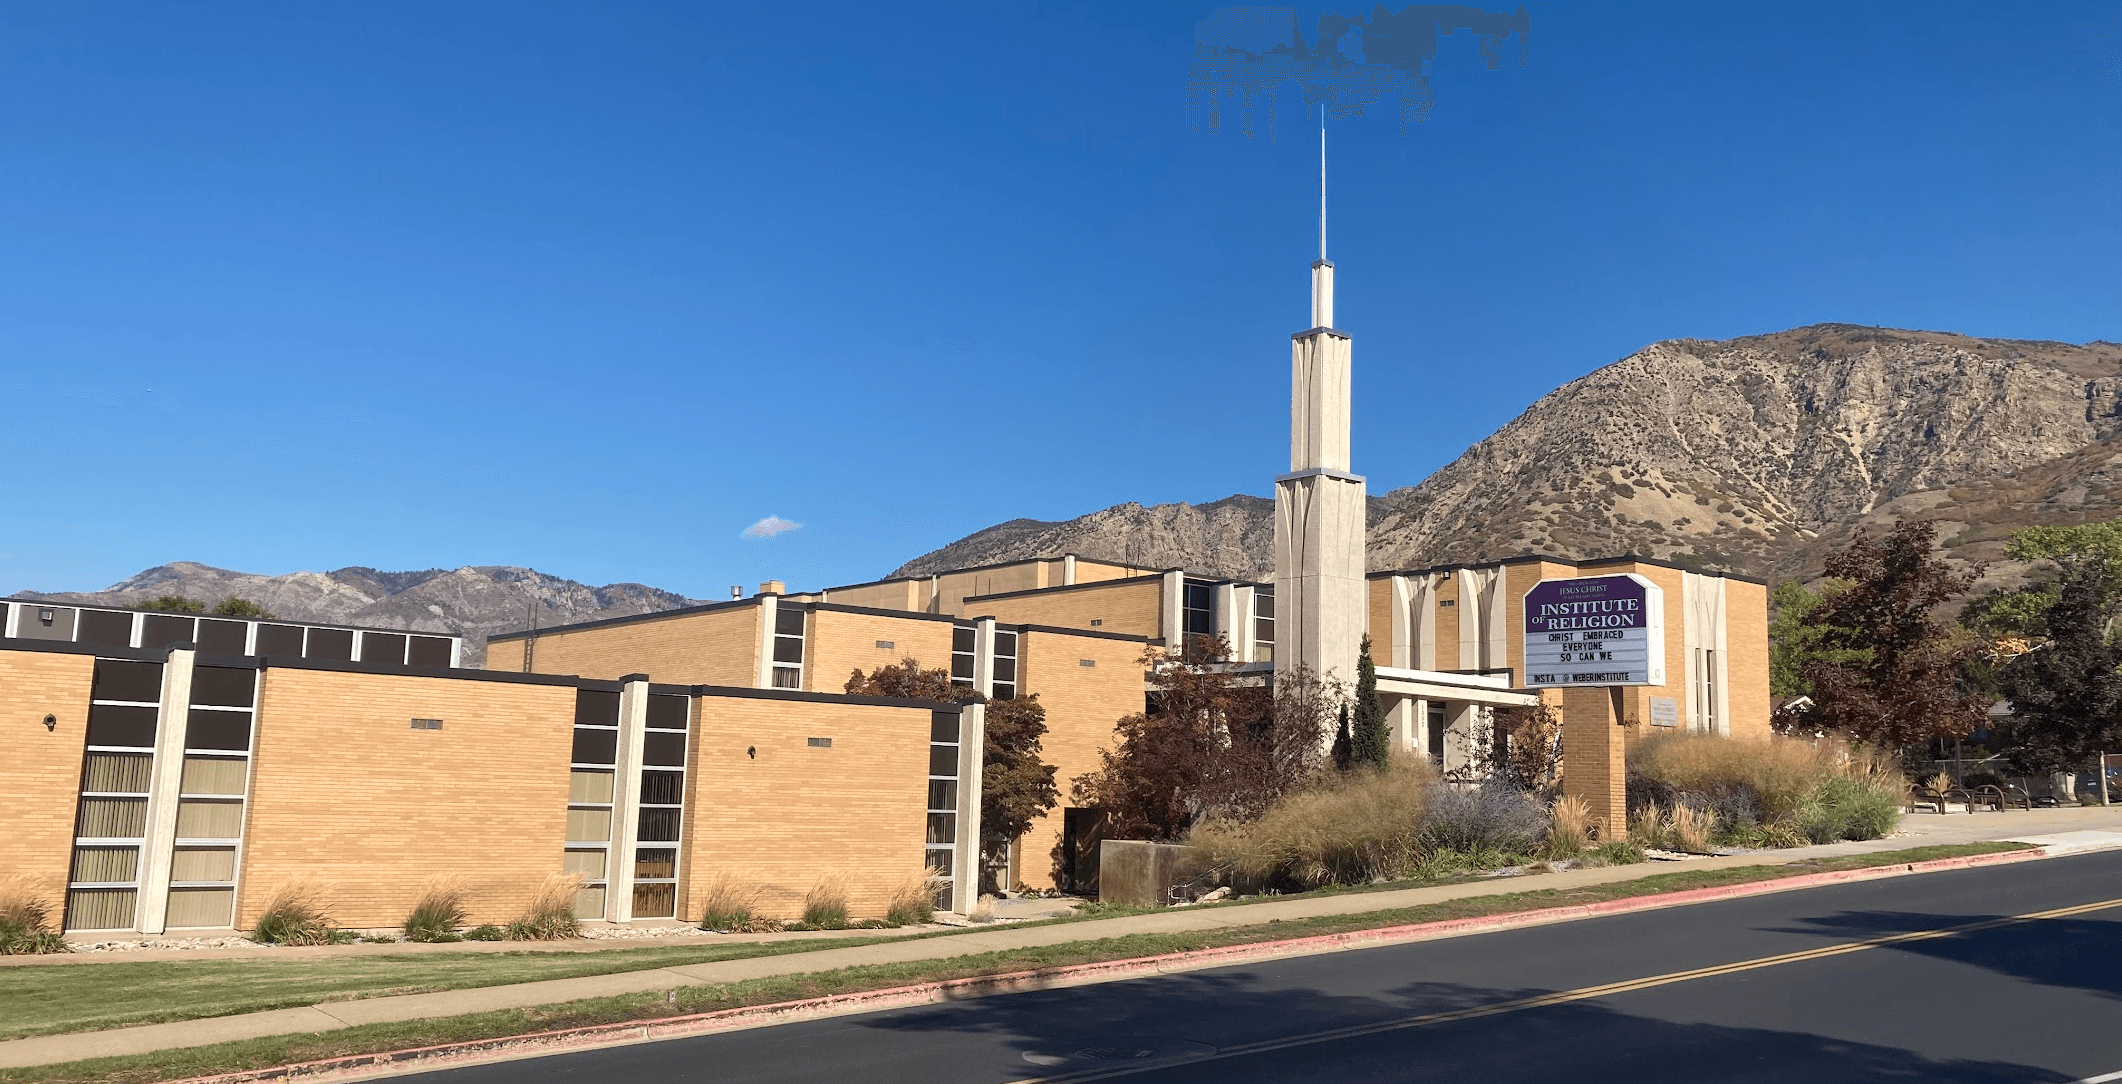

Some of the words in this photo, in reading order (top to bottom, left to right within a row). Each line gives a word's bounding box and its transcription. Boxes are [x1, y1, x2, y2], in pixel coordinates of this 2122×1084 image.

[1560, 587, 1580, 595] JESUS
[1581, 585, 1607, 594] CHRIST
[1540, 598, 1639, 616] INSTITUTE
[1532, 616, 1546, 624] OF
[1547, 614, 1635, 630] RELIGION
[1548, 633, 1574, 642] CHRIST
[1583, 630, 1624, 640] EMBRACED
[1562, 641, 1603, 651] EVERYONE
[1561, 653, 1572, 662] SO
[1579, 652, 1595, 661] CAN
[1600, 651, 1613, 661] WE
[1534, 674, 1556, 683] INSTA
[1572, 672, 1630, 682] WEBERINSTITUTE
